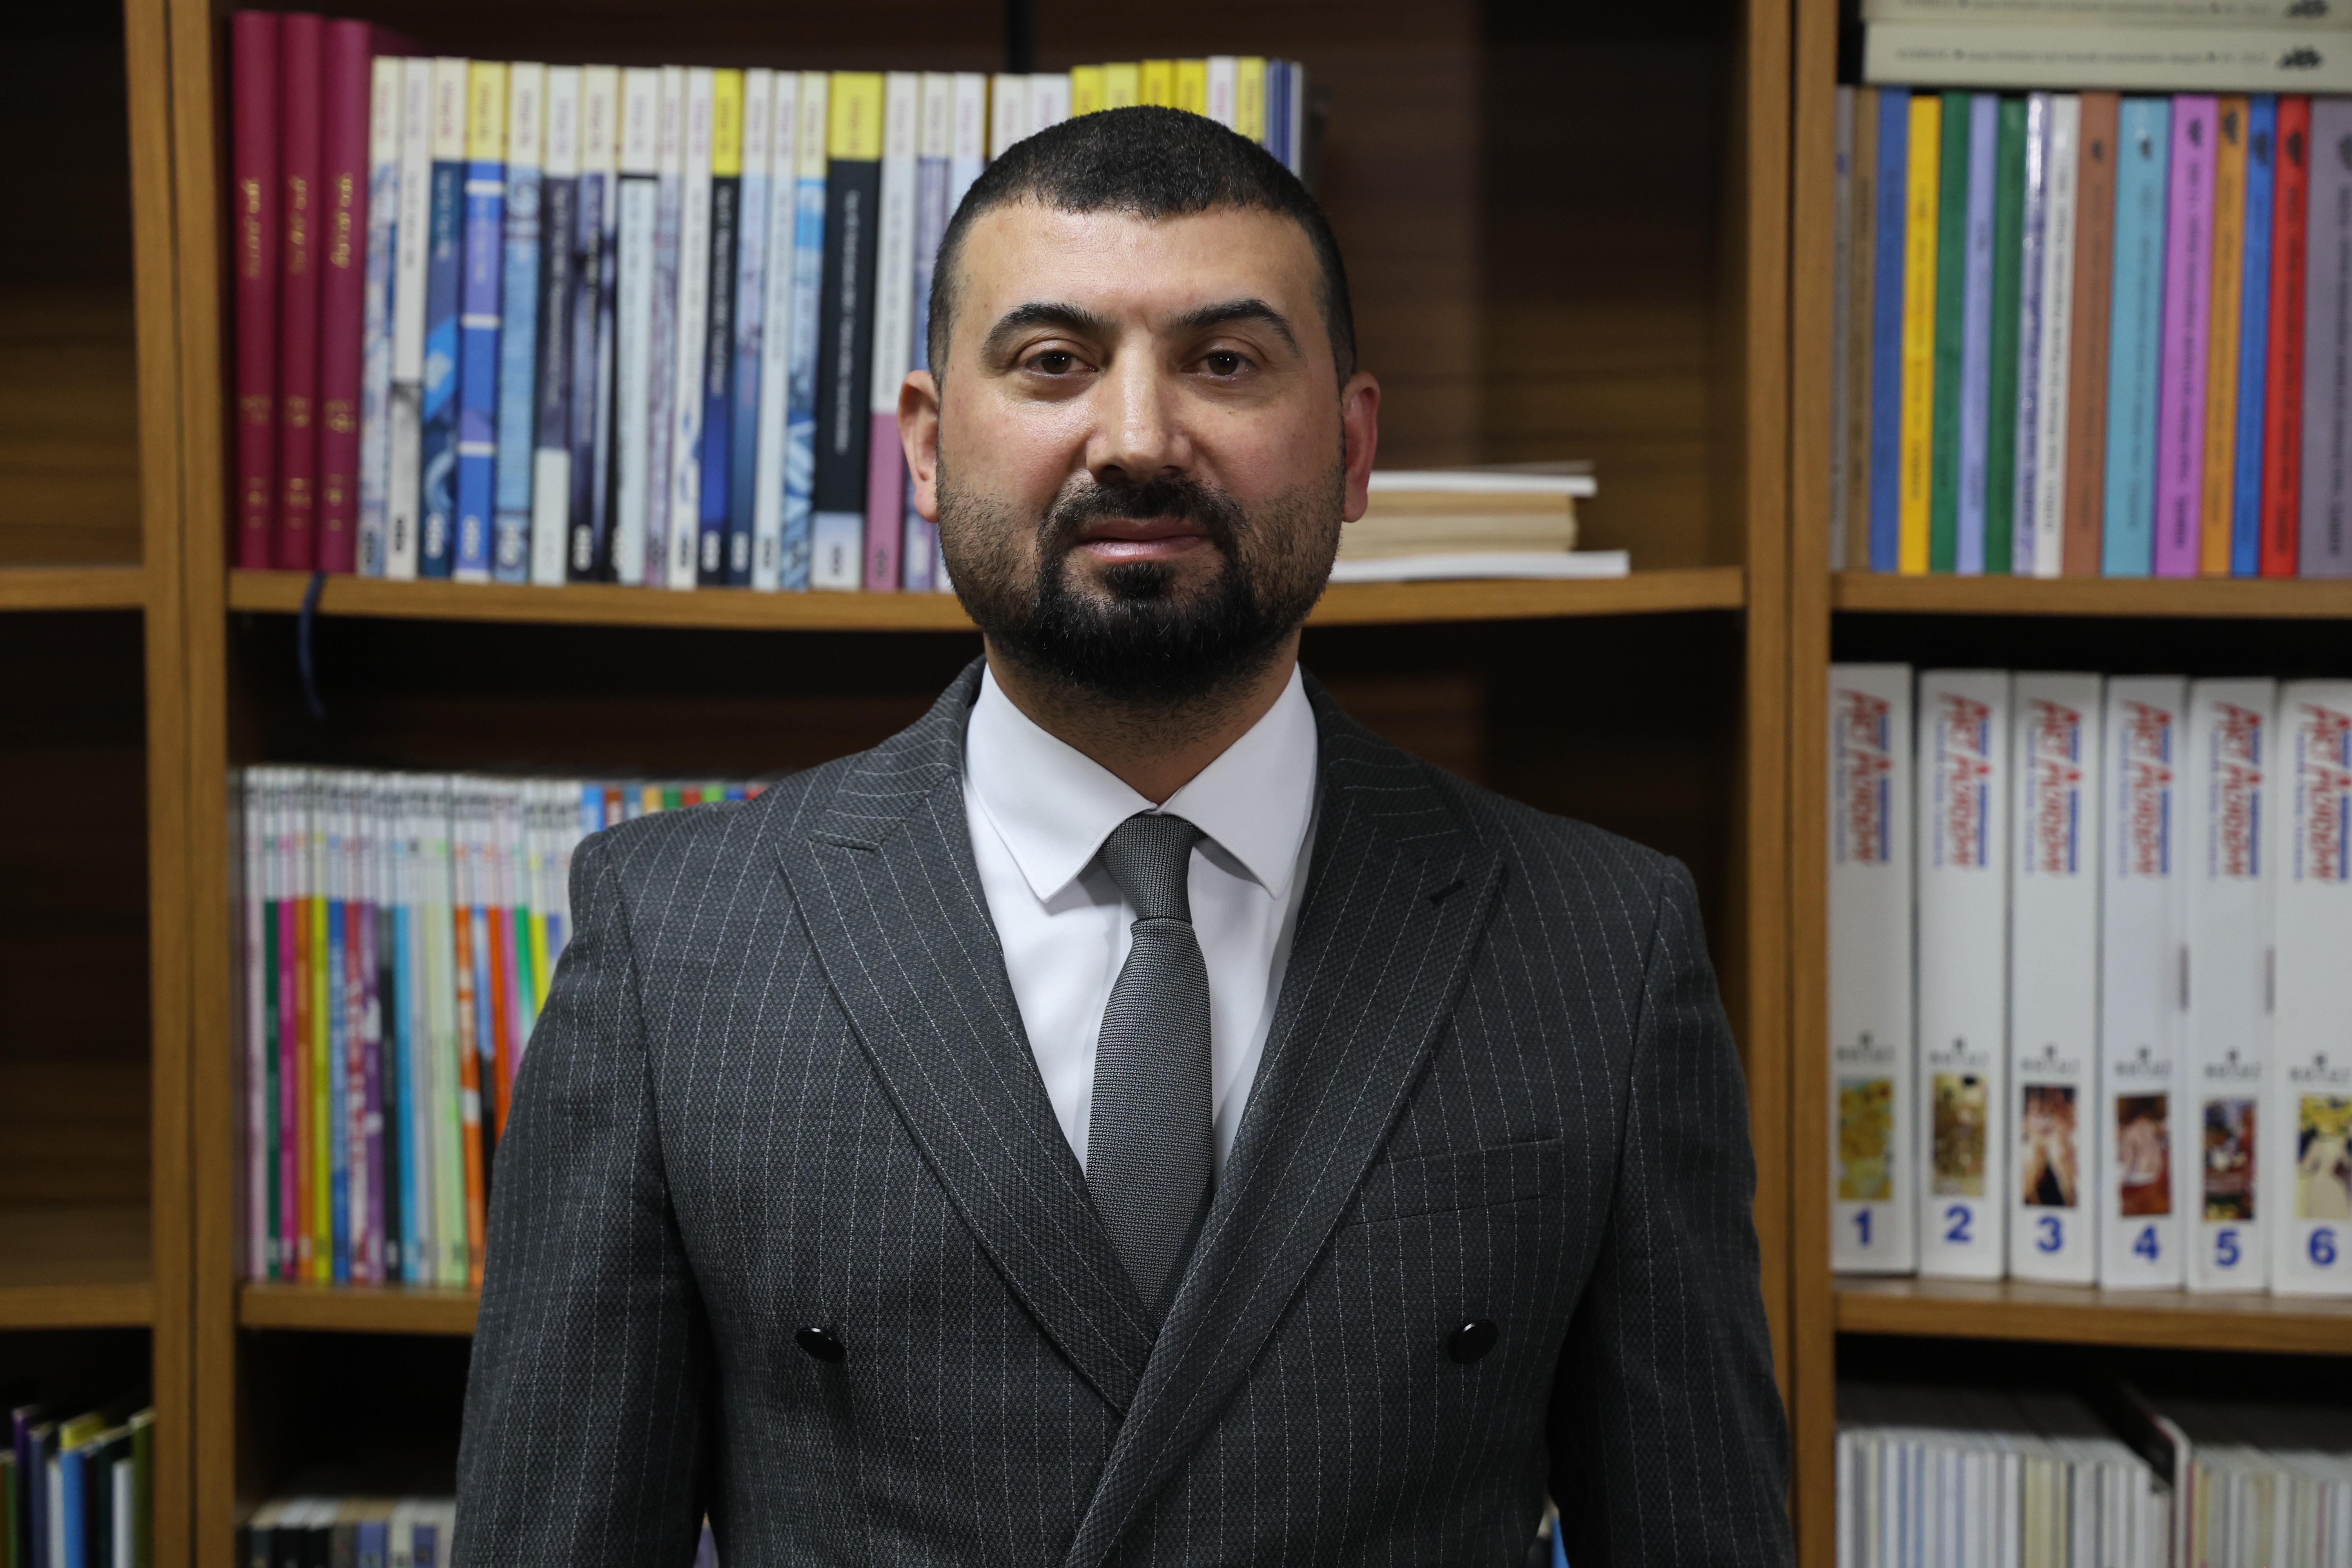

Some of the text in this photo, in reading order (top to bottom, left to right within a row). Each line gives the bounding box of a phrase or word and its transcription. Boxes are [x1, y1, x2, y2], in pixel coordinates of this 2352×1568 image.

[1853, 1210, 1871, 1245] 1
[1947, 1206, 1972, 1242] 2
[2038, 1216, 2063, 1252] 3
[2134, 1227, 2159, 1261] 4
[2218, 1230, 2240, 1267] 5
[2309, 1229, 2336, 1265] 6
